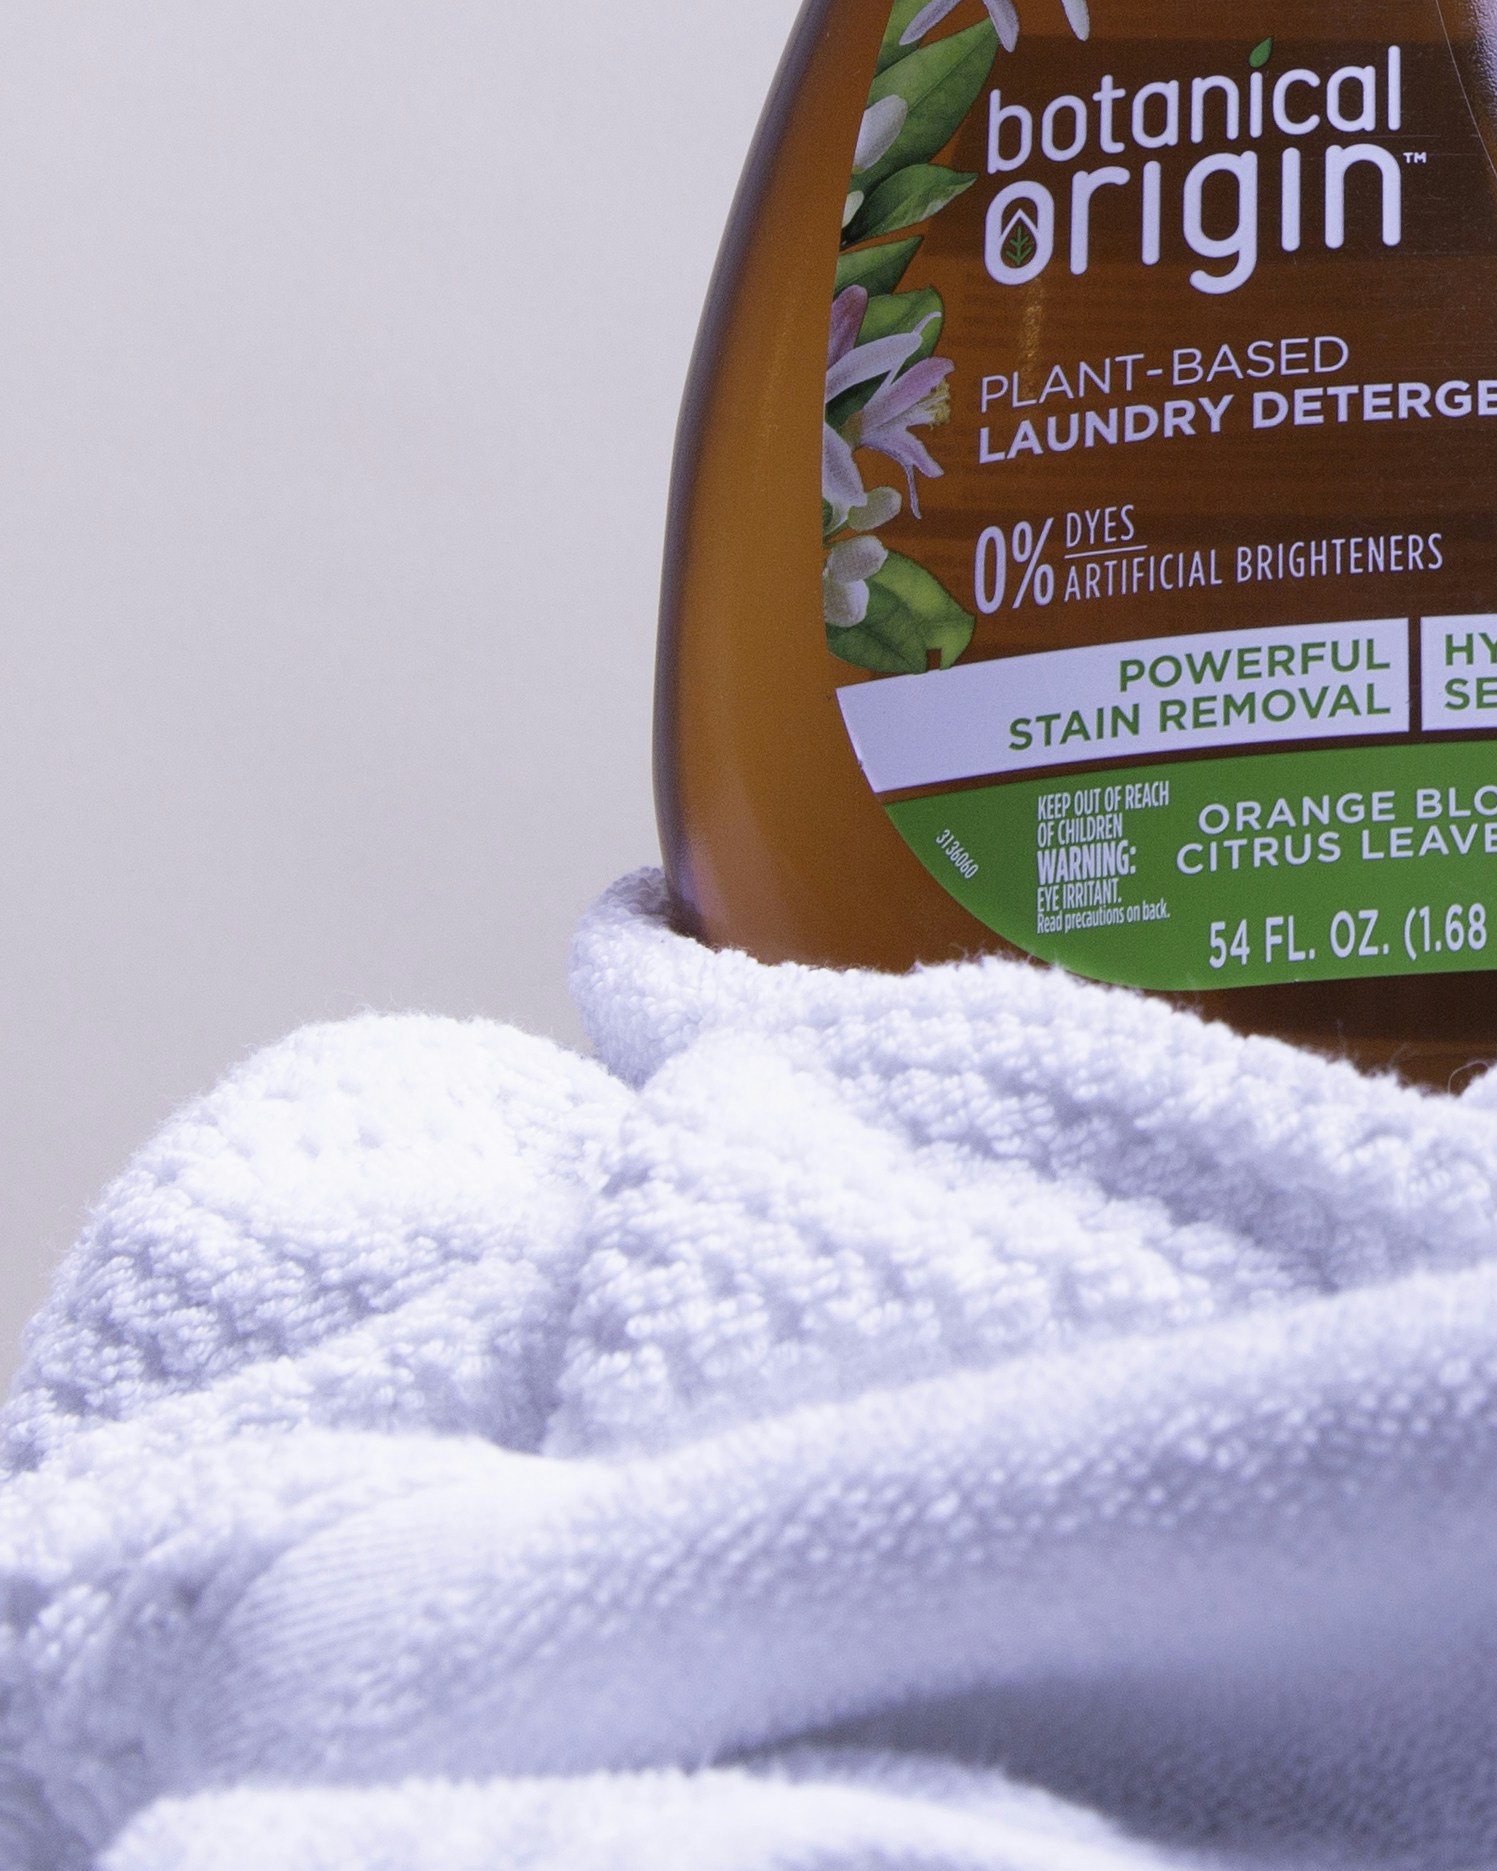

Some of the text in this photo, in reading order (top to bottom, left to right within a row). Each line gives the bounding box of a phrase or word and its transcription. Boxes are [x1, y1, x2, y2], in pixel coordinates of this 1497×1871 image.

[986, 36, 1401, 175] botanical
[979, 336, 1350, 413] PLANT-BASED
[978, 394, 1241, 464] LAUNDRY
[1065, 504, 1136, 549] DYES
[973, 518, 1055, 614] 0%
[1063, 533, 1444, 602] ARTIFICIAL BRIGHTENERS
[1118, 636, 1391, 693] POWERFUL
[1008, 682, 1391, 752] STAIN REMOVAL
[1038, 780, 1170, 821] KEEP OUT OF REACH
[1197, 790, 1396, 836] ORANGE
[935, 828, 979, 880] 3136060
[1037, 812, 1123, 848] OF CHILDREN
[1176, 832, 1342, 875] CITRUS
[1037, 839, 1137, 886] WARNING:
[1037, 878, 1122, 913] EYE IRRITANT.
[1037, 897, 1171, 934] Read precautions on back.
[1208, 919, 1251, 969] 54
[1264, 914, 1316, 965] FL.
[1329, 909, 1390, 958] OZ.
[1403, 902, 1488, 961] (1.68
